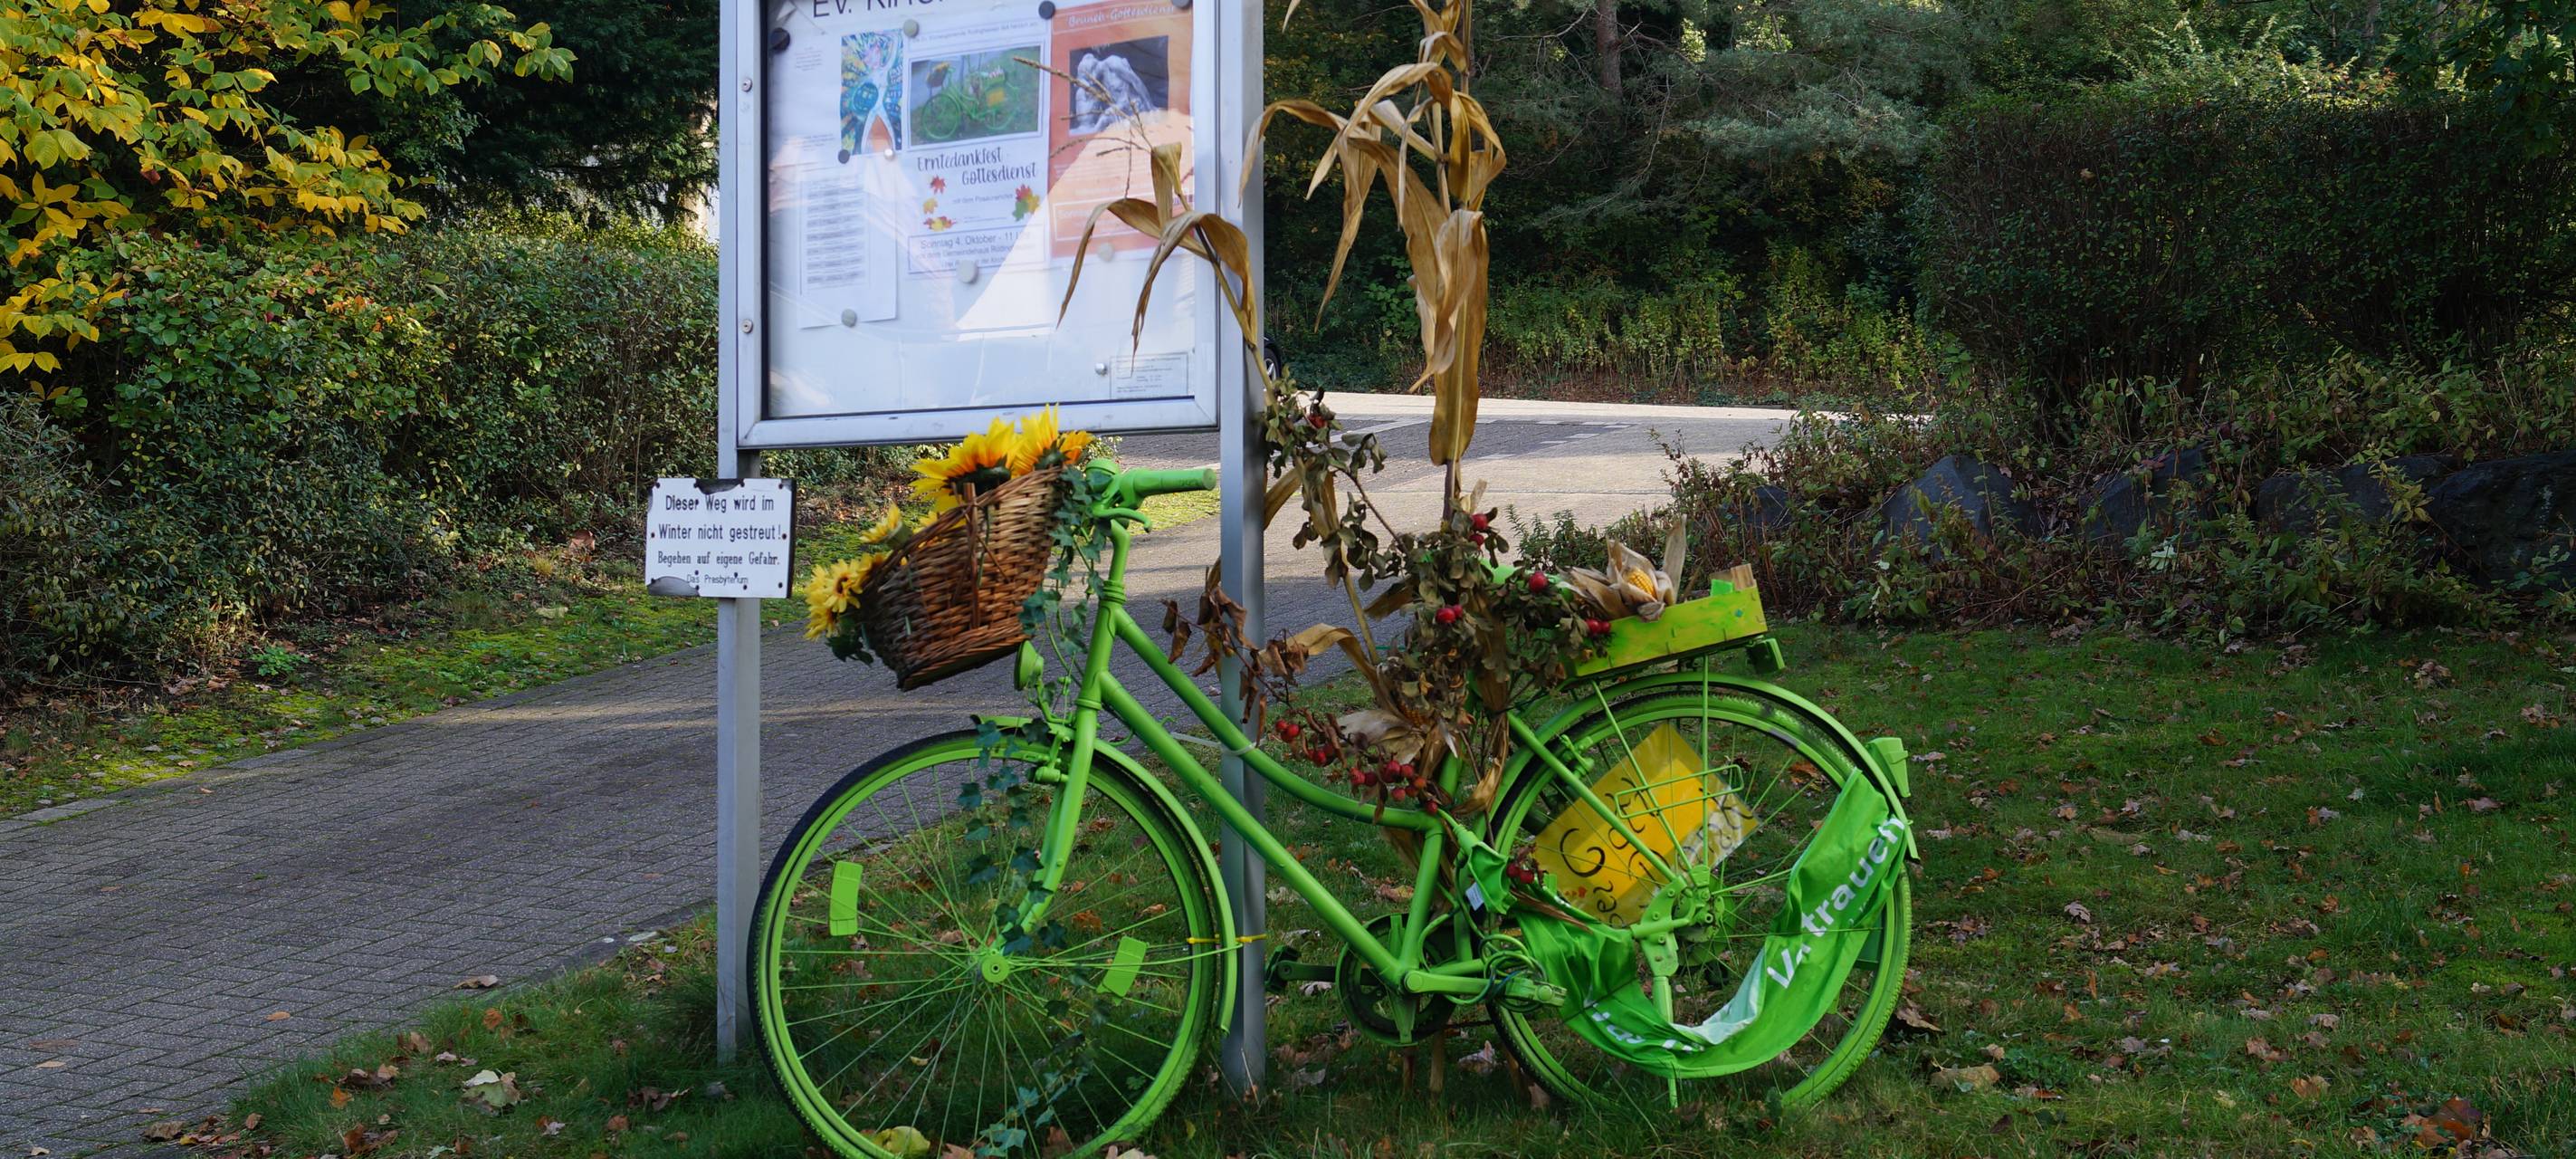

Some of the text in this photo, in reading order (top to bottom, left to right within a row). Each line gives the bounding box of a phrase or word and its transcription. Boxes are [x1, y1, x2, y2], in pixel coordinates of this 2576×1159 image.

[917, 147, 1002, 171] Erntedankfest
[962, 162, 1036, 186] Gottesdienst
[921, 236, 954, 250] Sonntag
[966, 233, 997, 245] Oktober
[665, 494, 775, 513] Dieser Weg wird im
[658, 524, 782, 542] Winter nicht gestreut!
[658, 551, 780, 568] Begehen auf eigene Gefahr.
